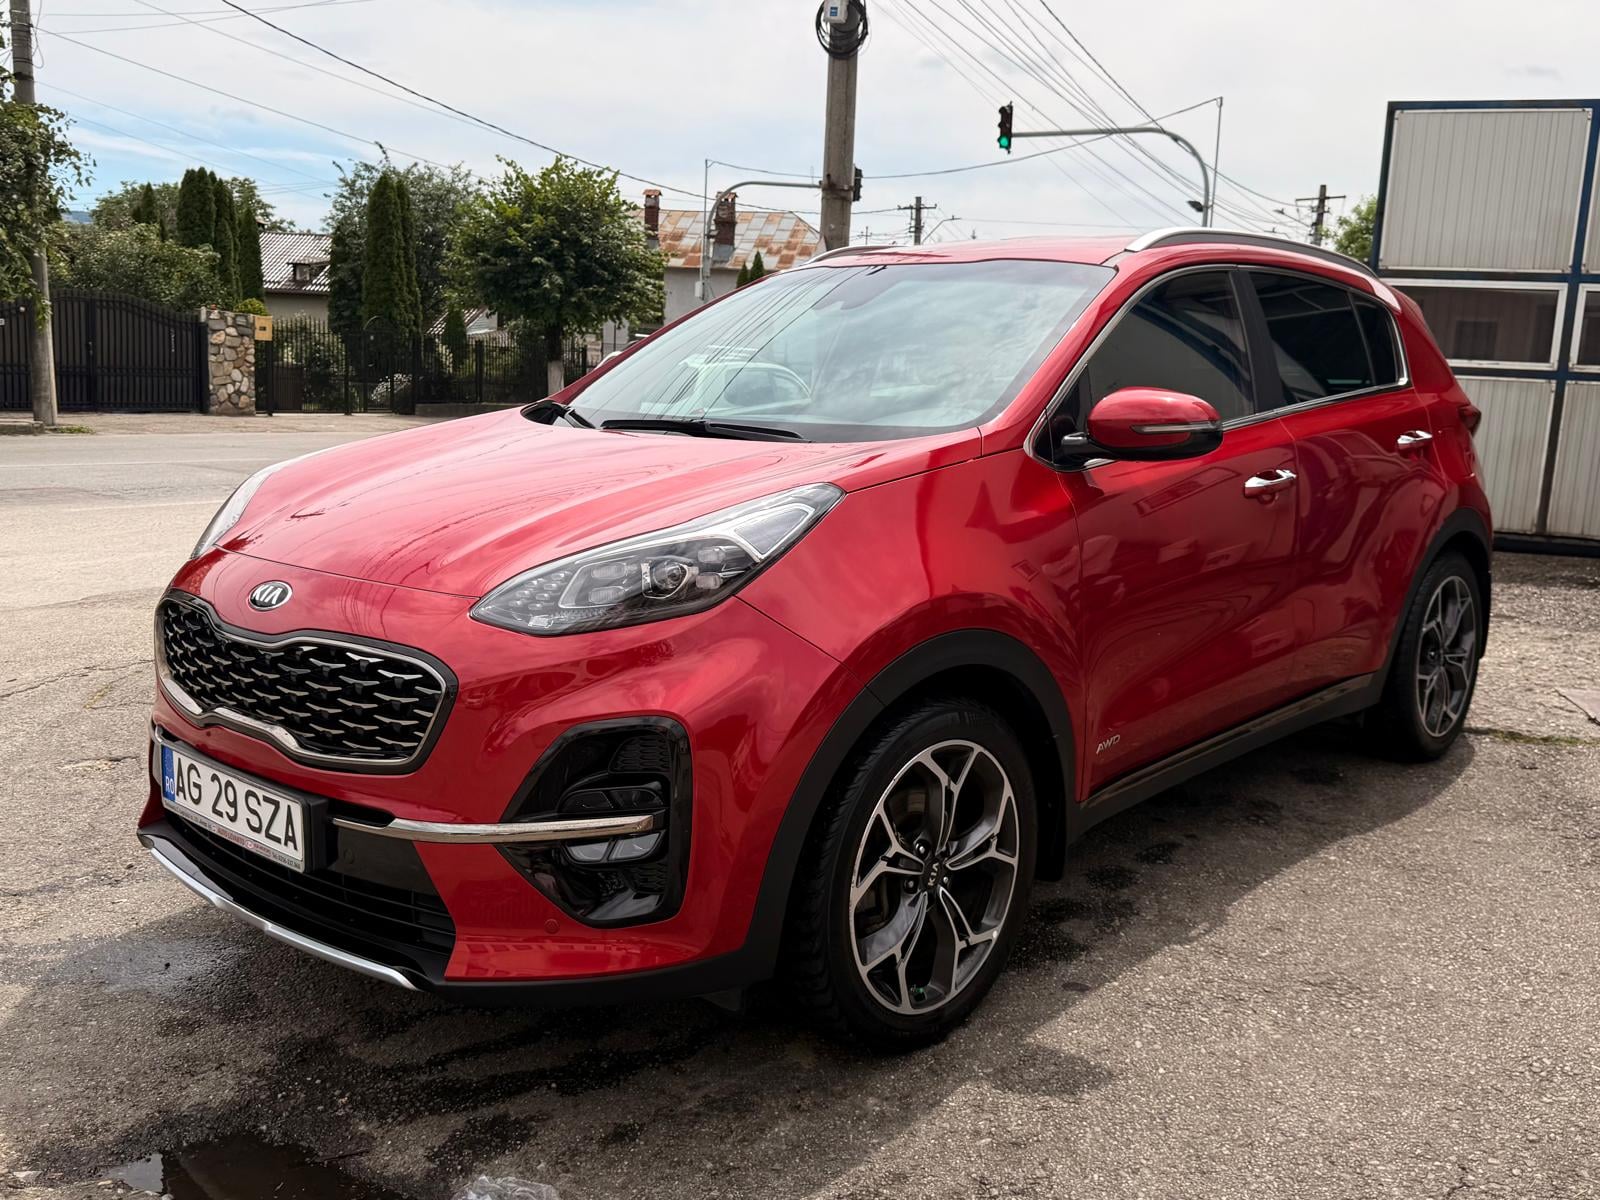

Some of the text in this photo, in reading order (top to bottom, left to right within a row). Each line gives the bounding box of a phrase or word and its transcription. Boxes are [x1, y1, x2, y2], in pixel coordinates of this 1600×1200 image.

[251, 584, 283, 605] KIA
[1096, 734, 1121, 755] AWD
[165, 776, 175, 795] RO
[176, 757, 202, 805] AG
[210, 773, 238, 823] 29
[244, 789, 298, 851] SZA
